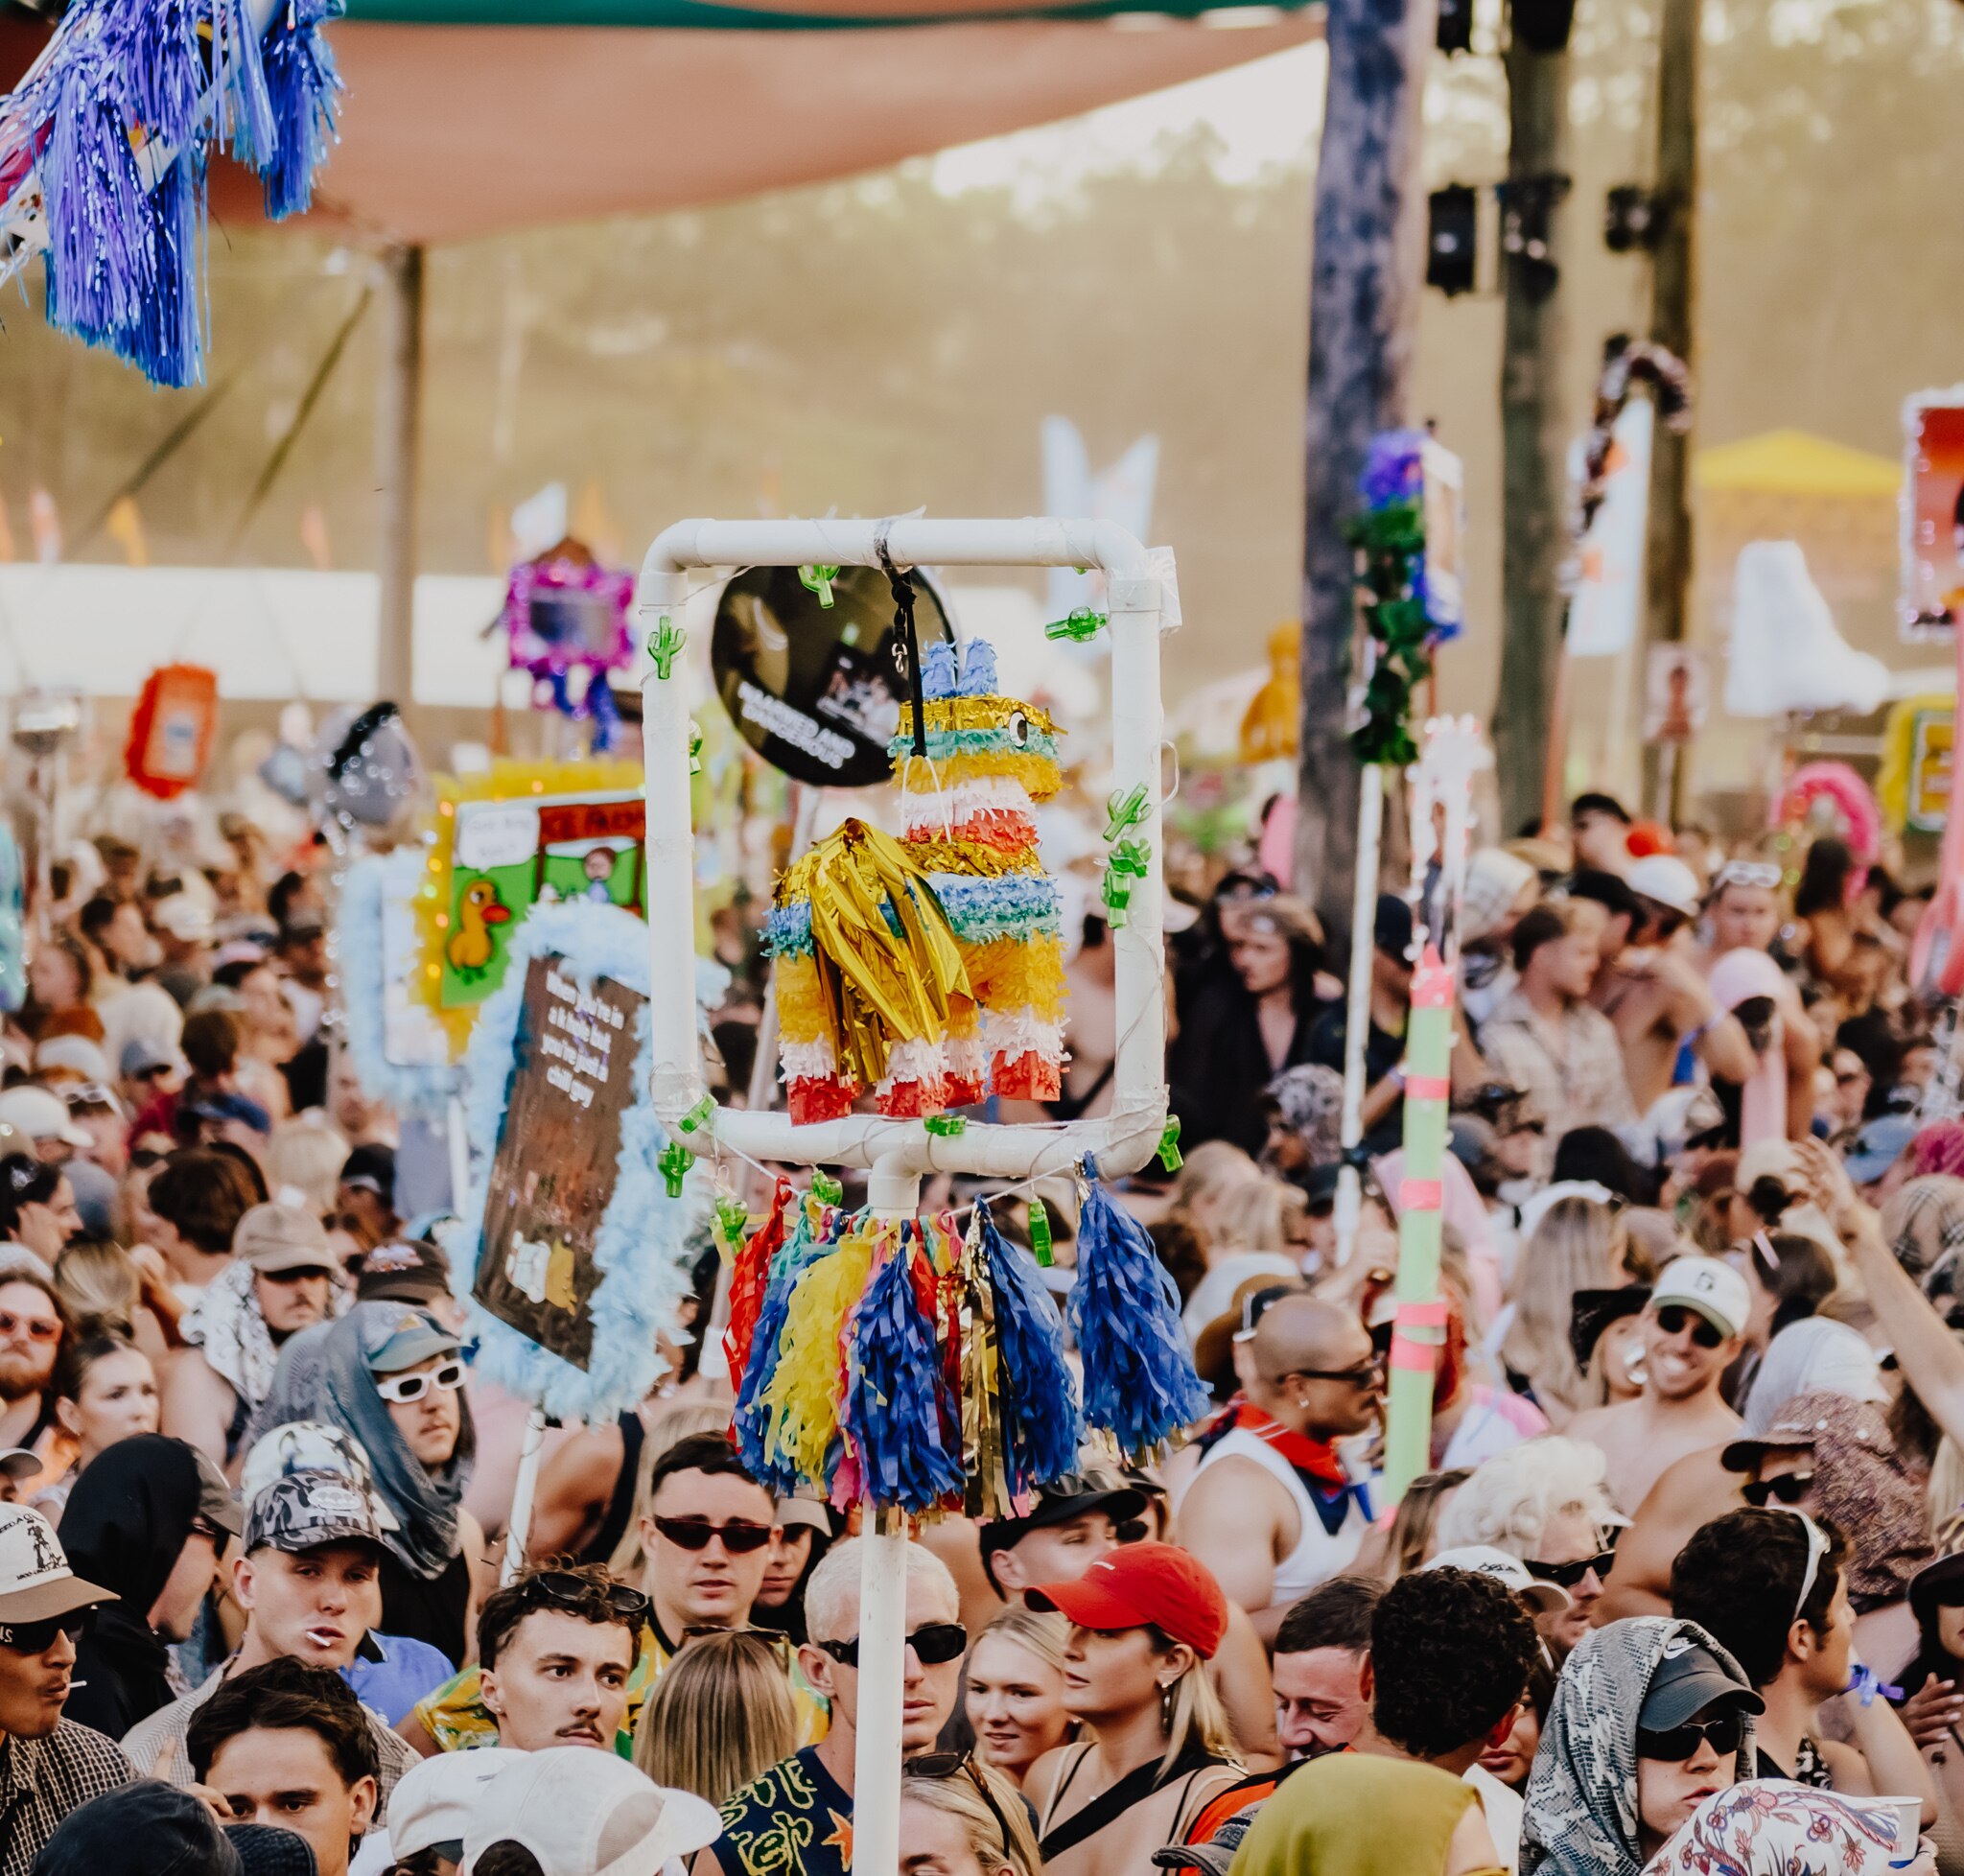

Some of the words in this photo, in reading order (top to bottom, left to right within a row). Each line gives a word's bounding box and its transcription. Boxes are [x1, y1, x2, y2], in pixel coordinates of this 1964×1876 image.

[741, 703, 844, 769] DANGEROUS
[817, 729, 856, 759] AND
[547, 971, 577, 1005] When
[611, 1005, 624, 1030] in
[565, 1012, 590, 1042] hole
[590, 1024, 612, 1053] but
[541, 1034, 577, 1065] you're
[575, 1050, 600, 1077] just
[596, 1065, 608, 1083] a
[547, 1067, 573, 1092] chill
[570, 1079, 595, 1108] guy
